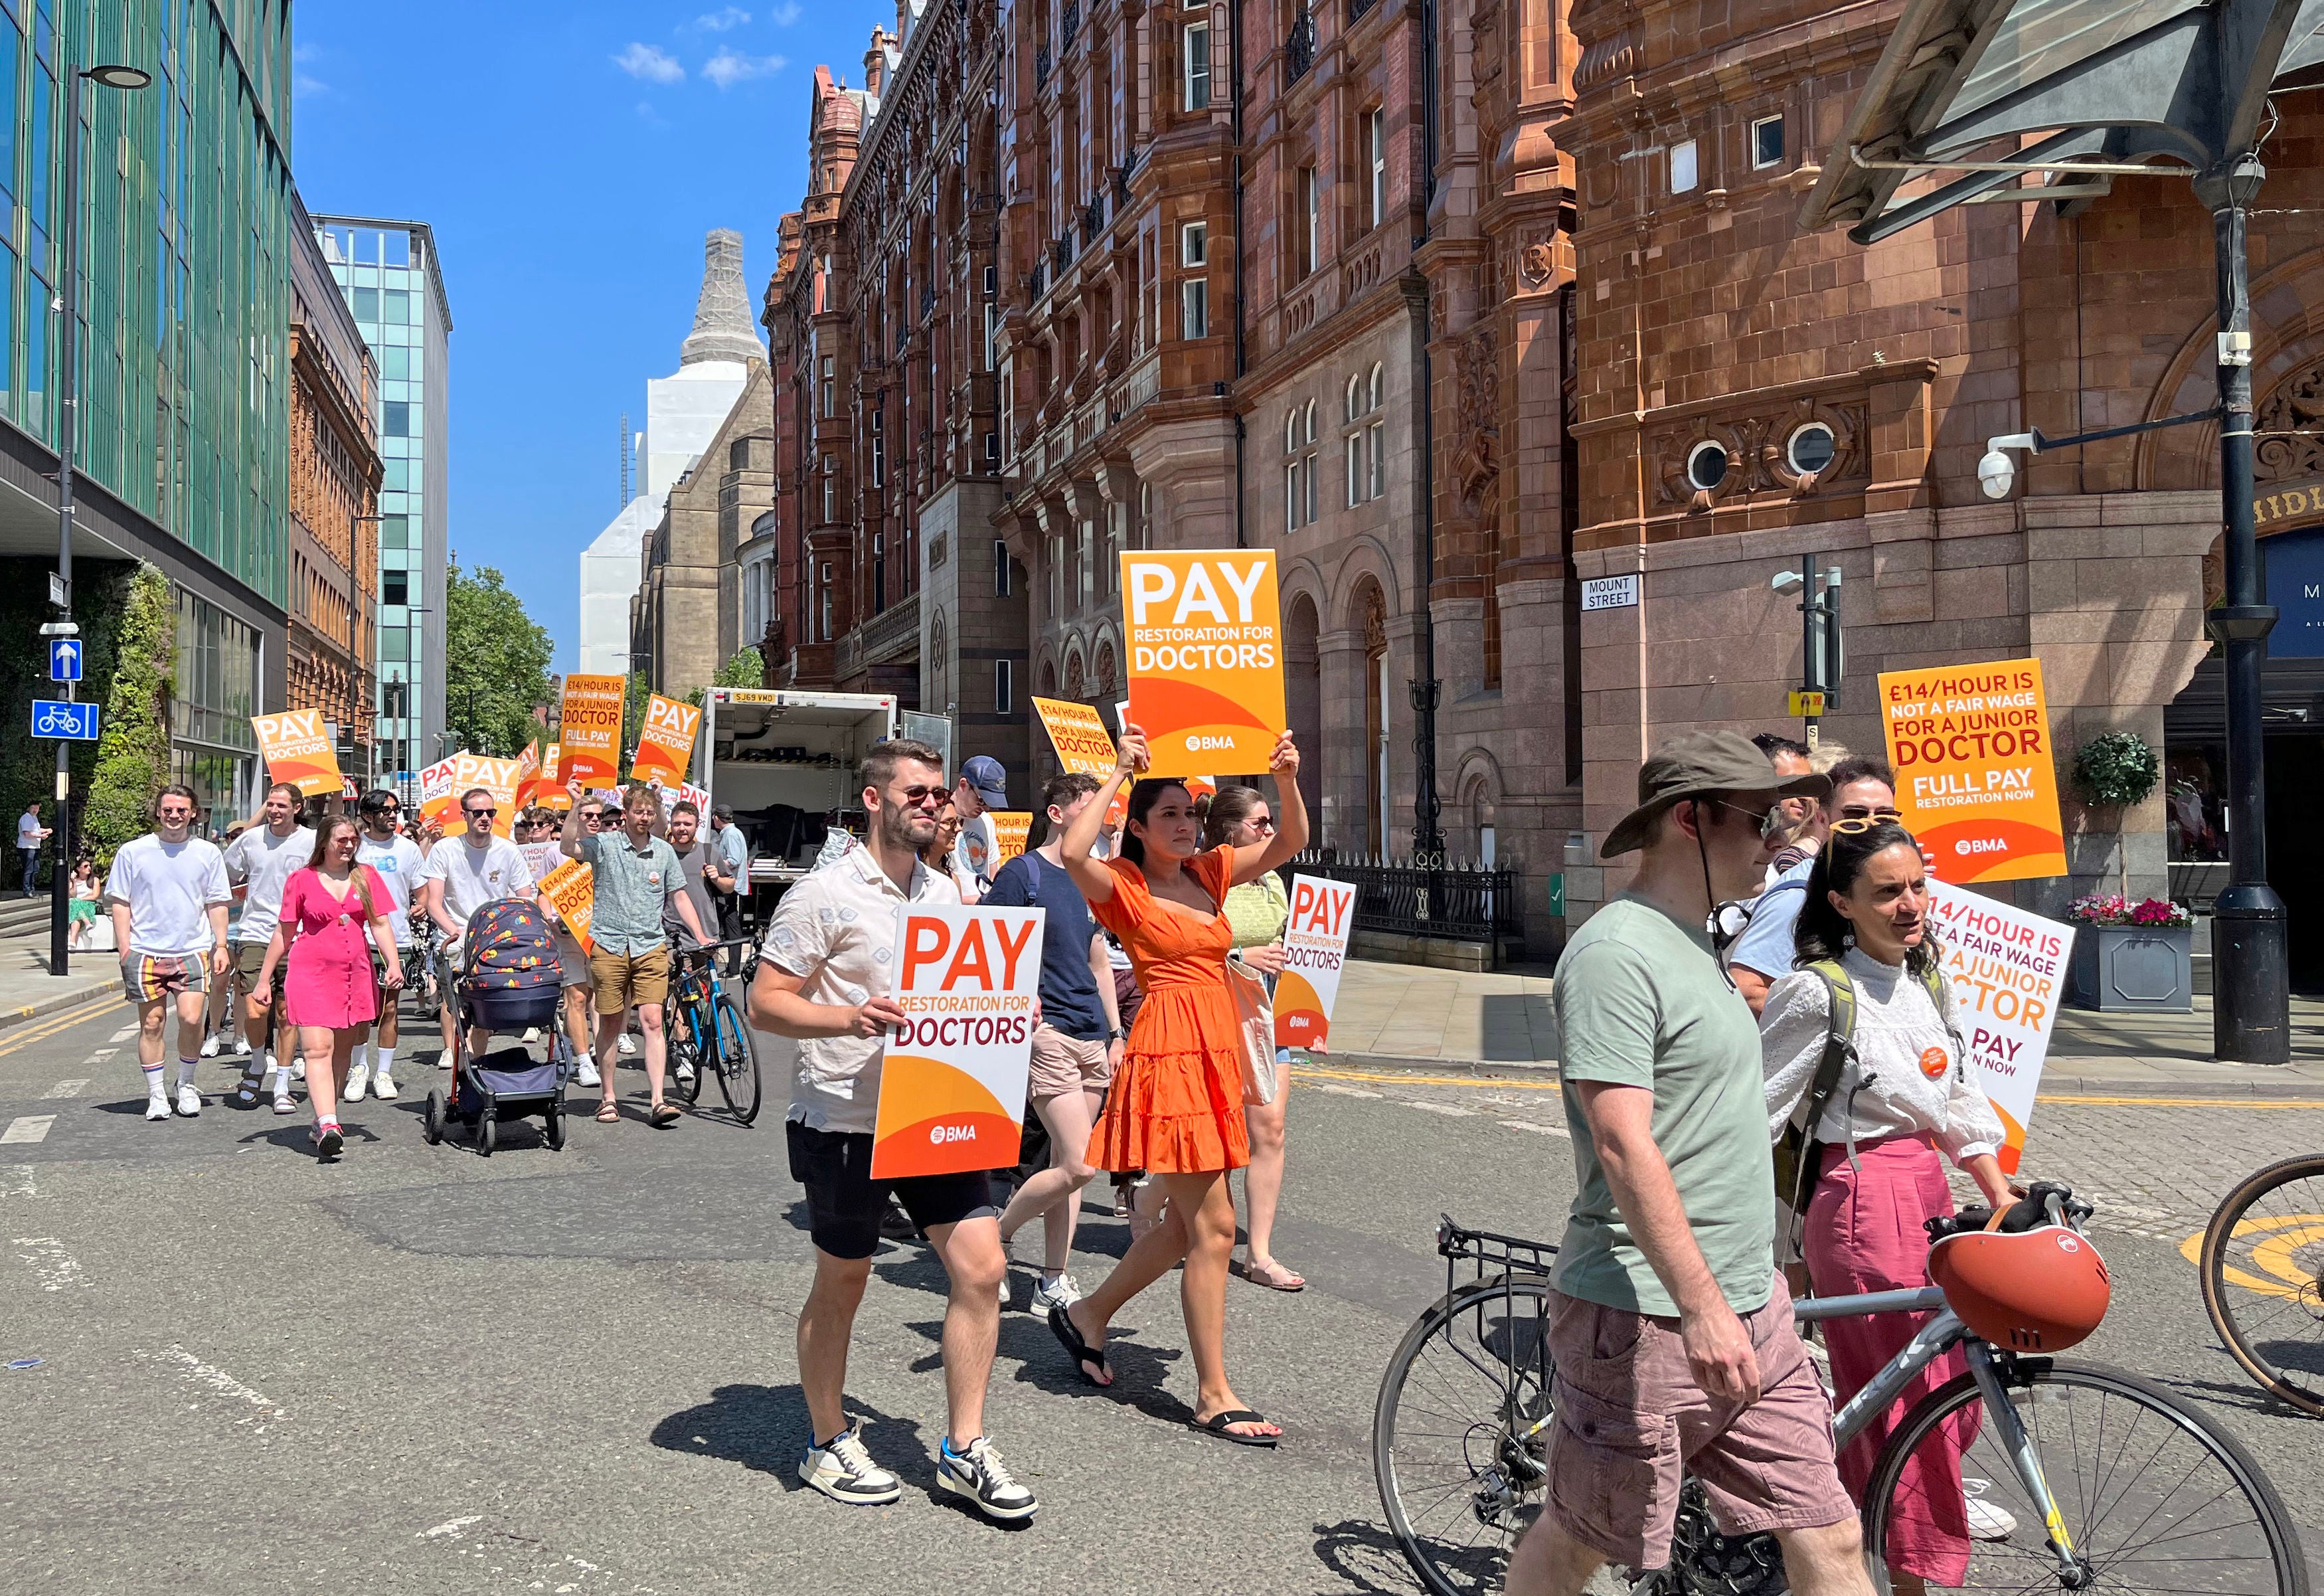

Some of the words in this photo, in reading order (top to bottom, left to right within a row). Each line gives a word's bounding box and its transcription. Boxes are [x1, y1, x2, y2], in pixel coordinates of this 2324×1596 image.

[1129, 561, 1268, 624] PAY
[1589, 578, 1629, 593] MOUNT
[1589, 592, 1629, 607] STREET
[1134, 627, 1240, 642] RESTORATION
[1243, 626, 1273, 640] FOR
[1135, 643, 1275, 671] DOCTORS
[568, 680, 610, 691] £14/HOUR
[612, 682, 621, 691] IS
[1889, 675, 2007, 701] £14/HOUR
[2013, 671, 2034, 689] IS
[565, 699, 578, 708] FOR
[586, 701, 619, 711] JUNIOR
[649, 698, 698, 733] PAY
[1040, 705, 1087, 719] £14/HOUR
[1088, 712, 1098, 722] IS
[1890, 703, 1926, 719] NOT
[1930, 701, 1943, 715] A
[1946, 696, 1984, 713] FAIR
[1986, 692, 2036, 709] WAGE
[564, 709, 618, 725] DOCTOR
[1045, 716, 1060, 725] NOT
[1083, 722, 1102, 731] WAGE
[1893, 719, 1935, 737] FOR
[1941, 717, 1956, 734] A
[1961, 709, 2038, 734] JUNIOR
[256, 712, 315, 744] PAY
[566, 729, 588, 741] FULL
[590, 731, 611, 742] PAY
[647, 723, 682, 739] RESTORATION
[1050, 725, 1068, 736] FOR
[1071, 729, 1077, 737] A
[1078, 730, 1108, 741] JUNIOR
[265, 738, 311, 749] RESTORATION
[267, 742, 328, 760] DOCTORS
[644, 729, 691, 752] DOCTORS
[1055, 736, 1115, 757] DOCTOR
[1202, 736, 1235, 750] BMA
[1895, 729, 2042, 766] DOCTOR
[457, 758, 517, 786] PAY
[1070, 758, 1099, 772] FULL
[1098, 762, 1116, 773] PAY
[1913, 772, 1981, 797] FULL
[1986, 767, 2033, 790] PAY
[680, 785, 708, 812] PAY
[1916, 791, 2002, 809] RESTORATION
[2005, 788, 2034, 801] NOW
[1972, 838, 2007, 853] BMA
[548, 887, 562, 897] NOT
[566, 872, 581, 885] FAIR
[553, 890, 570, 904] FOR
[1291, 883, 1351, 935] PAY
[1289, 932, 1332, 948] RESTORATION
[1332, 938, 1344, 949] FOR
[2039, 934, 2062, 957] IS
[900, 916, 1037, 990] PAY
[1285, 947, 1341, 970] DOCTORS
[1946, 927, 1958, 943] A
[1963, 932, 2003, 958] FAIR
[2006, 946, 2056, 977] WAGE
[1948, 950, 1964, 970] A
[1967, 956, 2052, 999] JUNIOR
[899, 996, 1001, 1012] RESTORATION
[1003, 996, 1029, 1011] FOR
[894, 1017, 1027, 1047] DOCTORS
[1295, 1016, 1309, 1027] BMA
[1971, 1027, 2024, 1062] PAY
[1985, 1057, 2017, 1077] NOW
[946, 1124, 976, 1142] BMA
[1831, 1333, 1926, 1430] TREK
